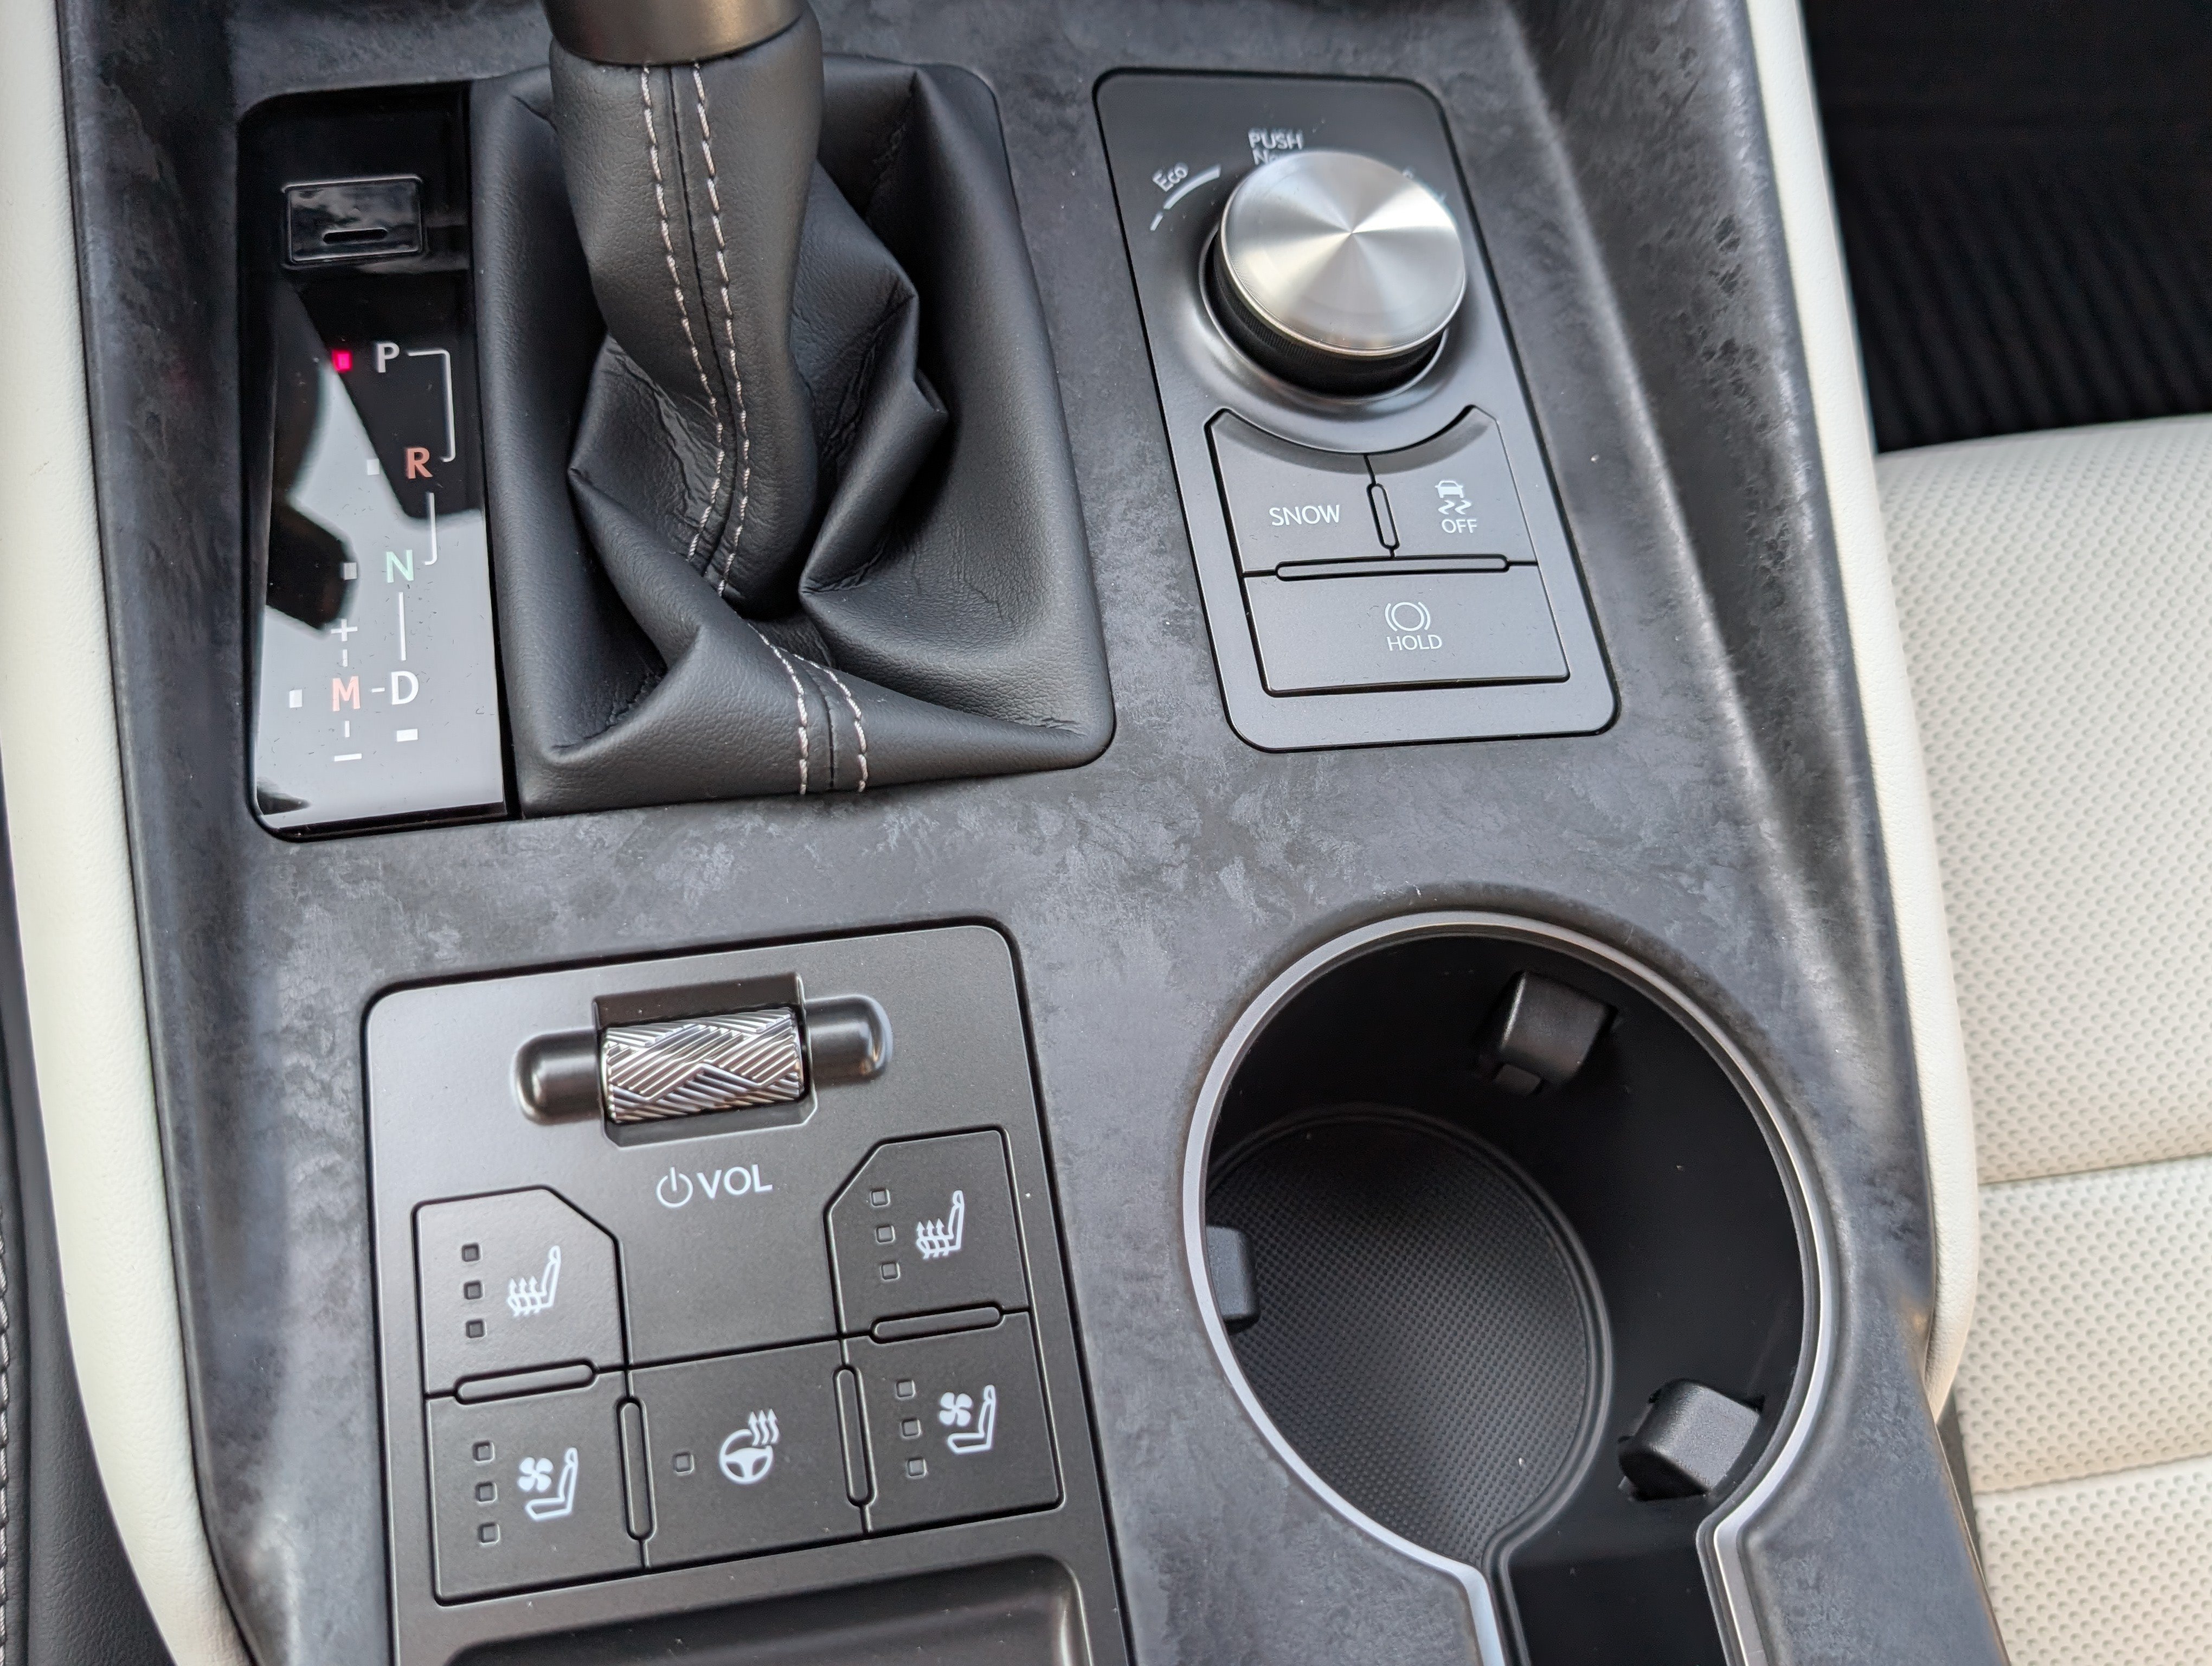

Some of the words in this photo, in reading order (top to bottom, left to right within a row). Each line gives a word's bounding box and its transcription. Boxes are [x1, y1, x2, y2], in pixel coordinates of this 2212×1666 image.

[1248, 129, 1303, 149] PUSH
[1153, 163, 1189, 191] Eco
[376, 342, 399, 373] P
[406, 447, 433, 479] R
[1269, 504, 1340, 526] SNOW
[1441, 518, 1477, 534] OFF
[386, 549, 414, 583] N
[1386, 635, 1443, 651] HOLD
[331, 675, 361, 712] M
[390, 670, 419, 705] D
[697, 1163, 773, 1200] VOL
